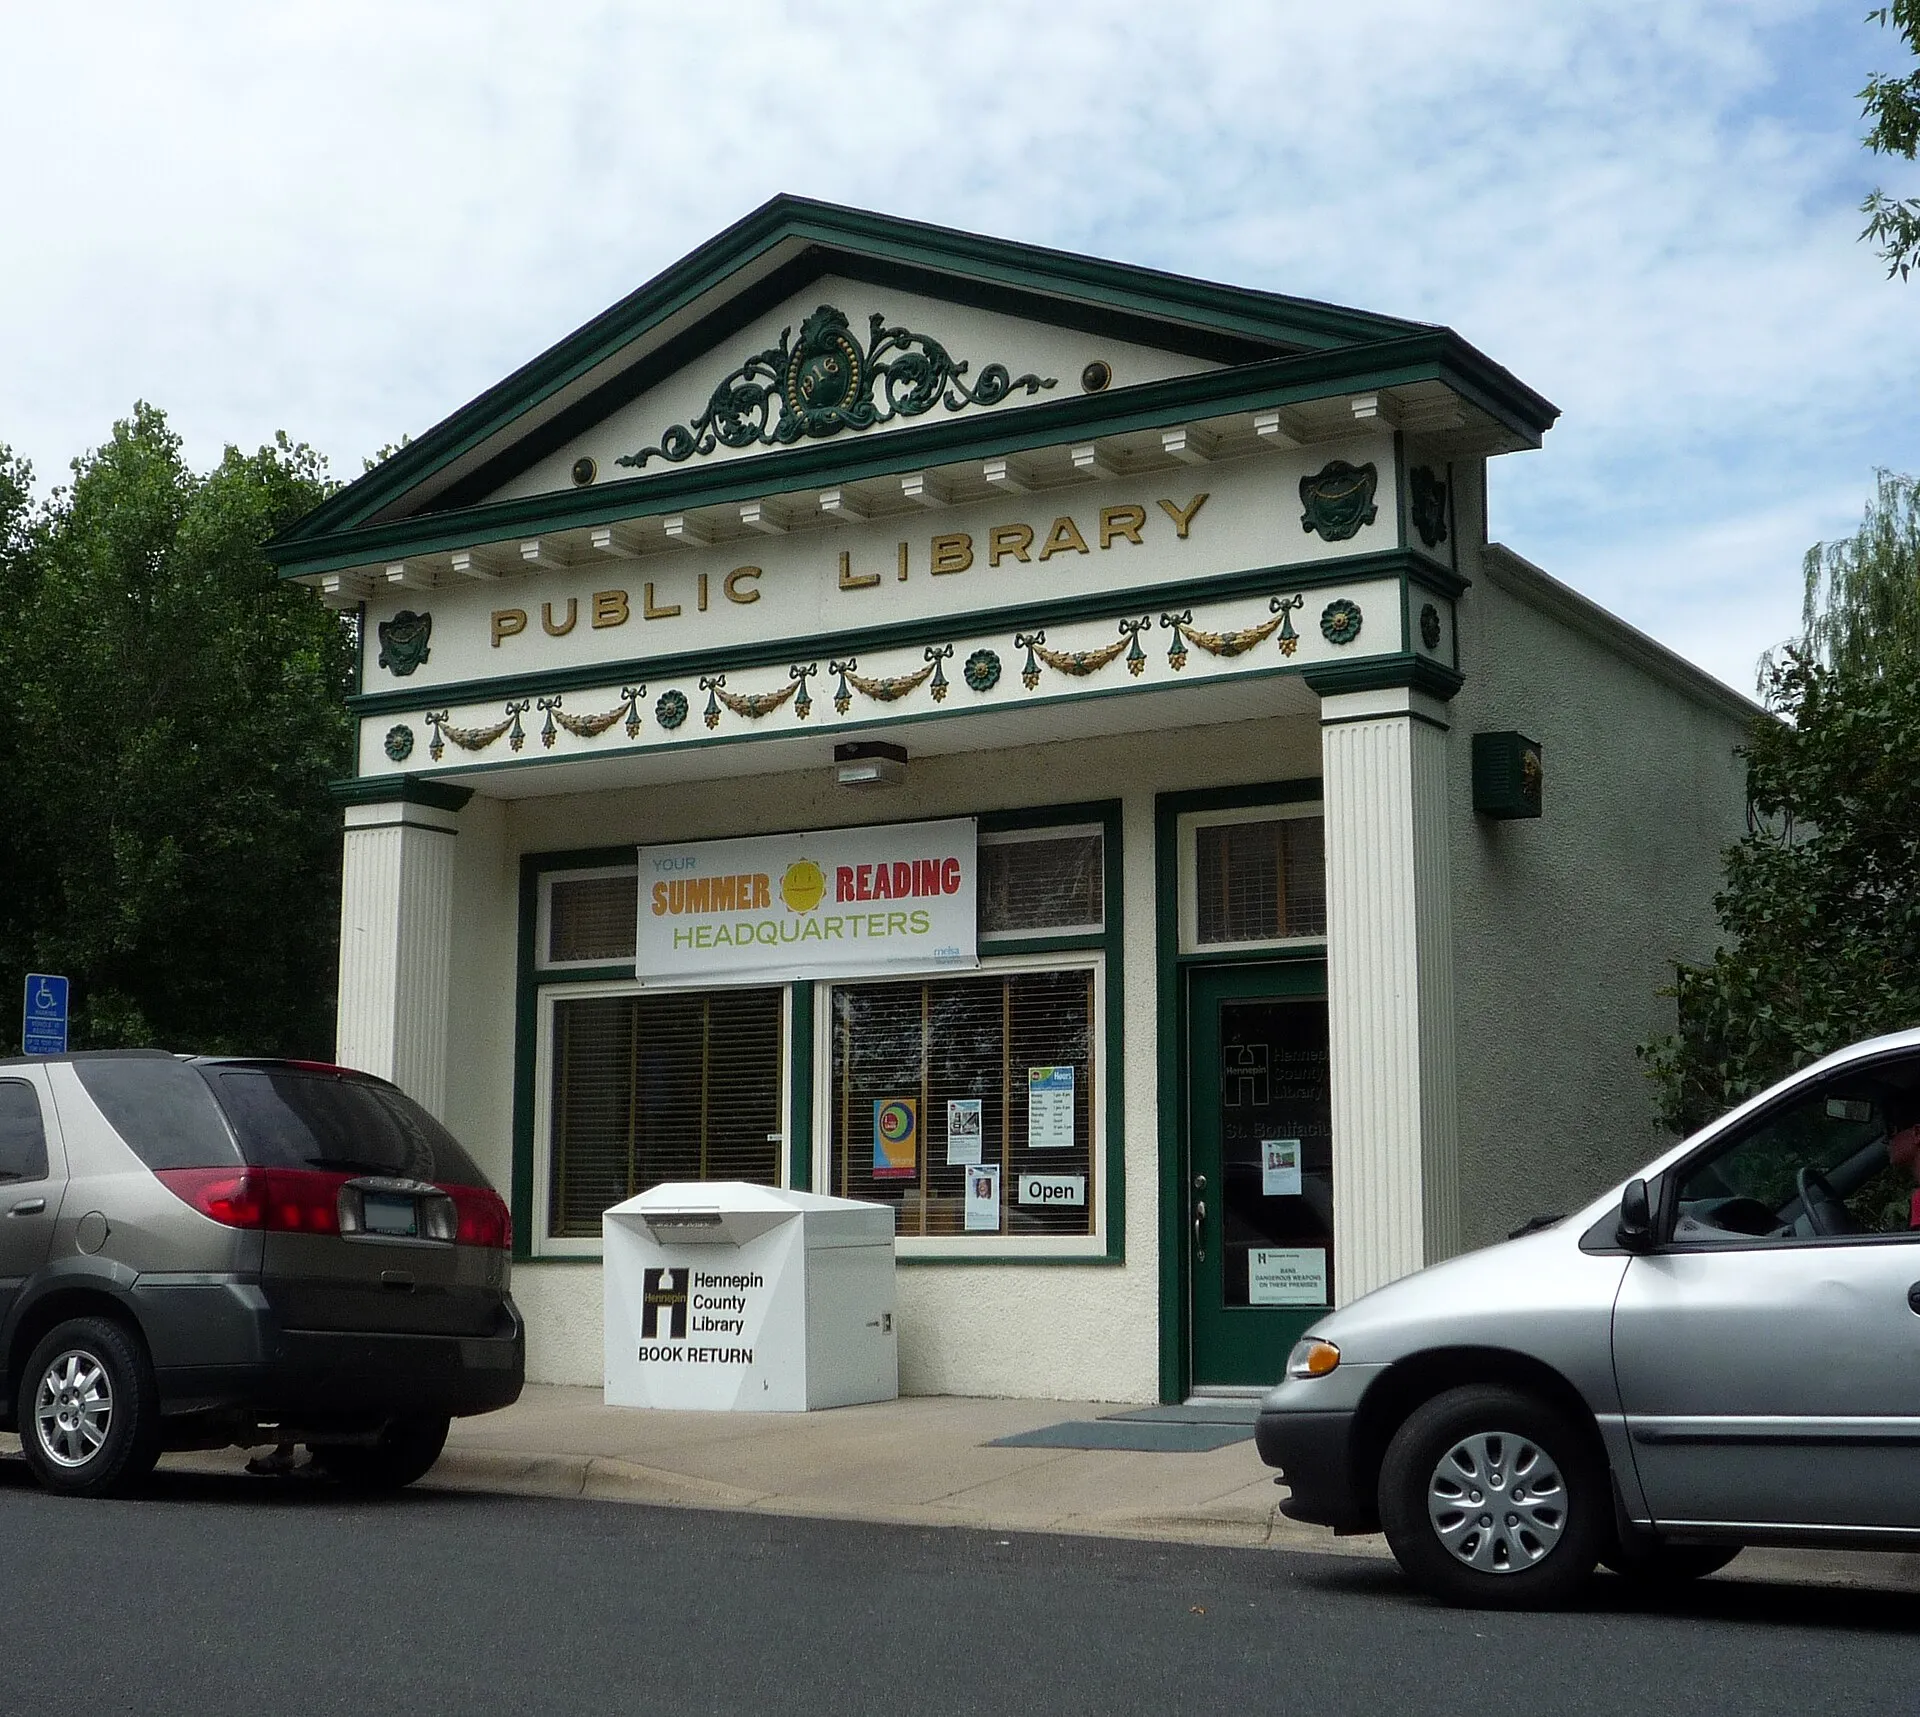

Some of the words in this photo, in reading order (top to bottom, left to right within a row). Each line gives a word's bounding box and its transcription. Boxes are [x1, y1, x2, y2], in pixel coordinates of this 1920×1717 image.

[800, 357, 839, 401] 1916
[491, 565, 763, 648] PUBLIC
[838, 492, 1210, 591] LIBRARY
[653, 856, 697, 872] YOUR
[651, 872, 772, 917] SUMMER
[836, 857, 962, 903] READING
[673, 909, 931, 950] HEADQUARTERS
[1274, 1047, 1330, 1064] Hennep
[1226, 1066, 1267, 1076] Hennepin
[1029, 1181, 1074, 1203] Open
[694, 1271, 763, 1292] Hennepin
[645, 1292, 686, 1304] Hennepin
[693, 1294, 746, 1314] County
[692, 1316, 744, 1336] Library
[639, 1346, 683, 1362] BOOK
[687, 1347, 753, 1364] RETURN
